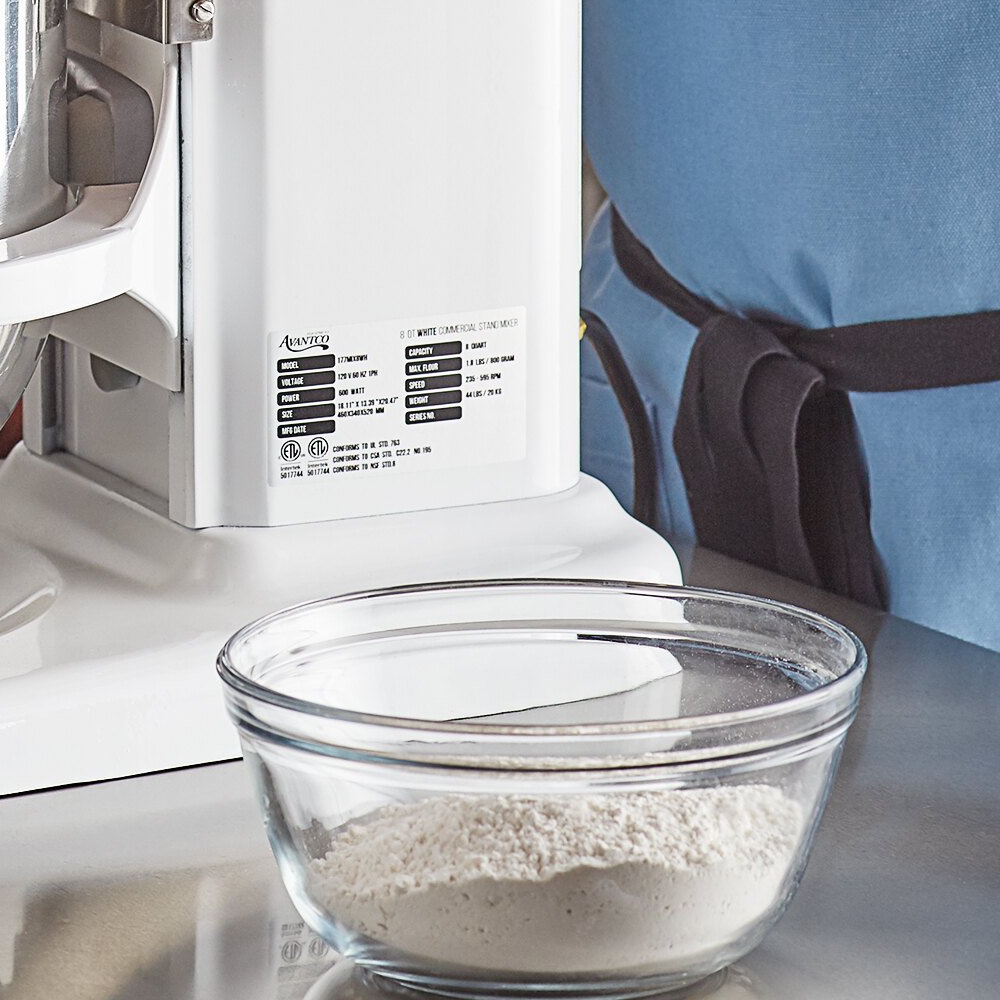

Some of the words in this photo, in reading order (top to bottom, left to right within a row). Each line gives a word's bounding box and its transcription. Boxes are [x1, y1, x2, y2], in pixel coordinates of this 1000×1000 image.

[417, 327, 437, 338] WHITE
[438, 323, 477, 335] COMMERCIAL
[479, 320, 499, 331] STAND
[500, 318, 518, 328] MIXER
[279, 334, 330, 352] AVANTCO
[409, 347, 433, 356] CAPACITY
[281, 361, 299, 370] MODEL
[423, 363, 439, 371] FLOUR
[281, 377, 304, 386] VOLTAGE
[409, 381, 425, 389] SPEED
[281, 394, 300, 403] POWER
[409, 396, 429, 405] WEIGHT
[281, 410, 293, 419] SIZE
[409, 413, 426, 421] SERIES
[281, 426, 293, 435] MFG
[294, 425, 307, 434] DATE
[332, 444, 360, 452] CONFORMS
[332, 454, 360, 463] CONFORMS
[307, 468, 329, 476] 5017744
[332, 465, 360, 473] CONFORMS
[280, 471, 303, 479] 5017744
